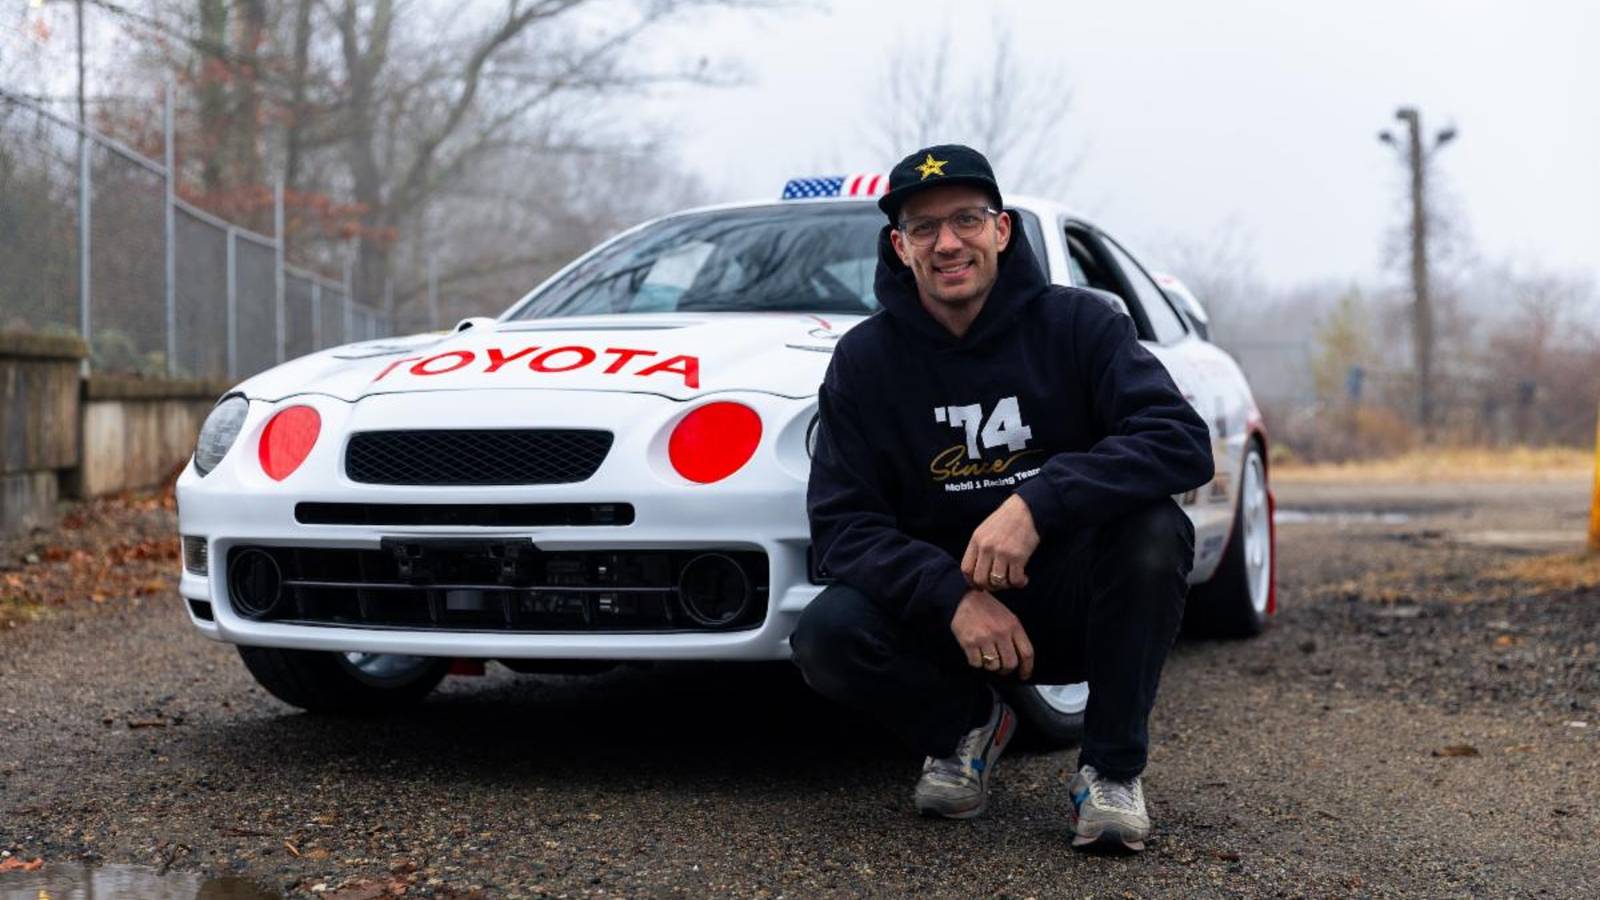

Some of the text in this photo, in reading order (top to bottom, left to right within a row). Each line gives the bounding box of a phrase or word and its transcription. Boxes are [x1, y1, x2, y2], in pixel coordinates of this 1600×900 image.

[373, 346, 700, 389] TOYOTA
[934, 396, 1032, 460] '74
[930, 445, 1043, 480] Since
[945, 467, 1041, 492] Mobil 1 Racing Team
